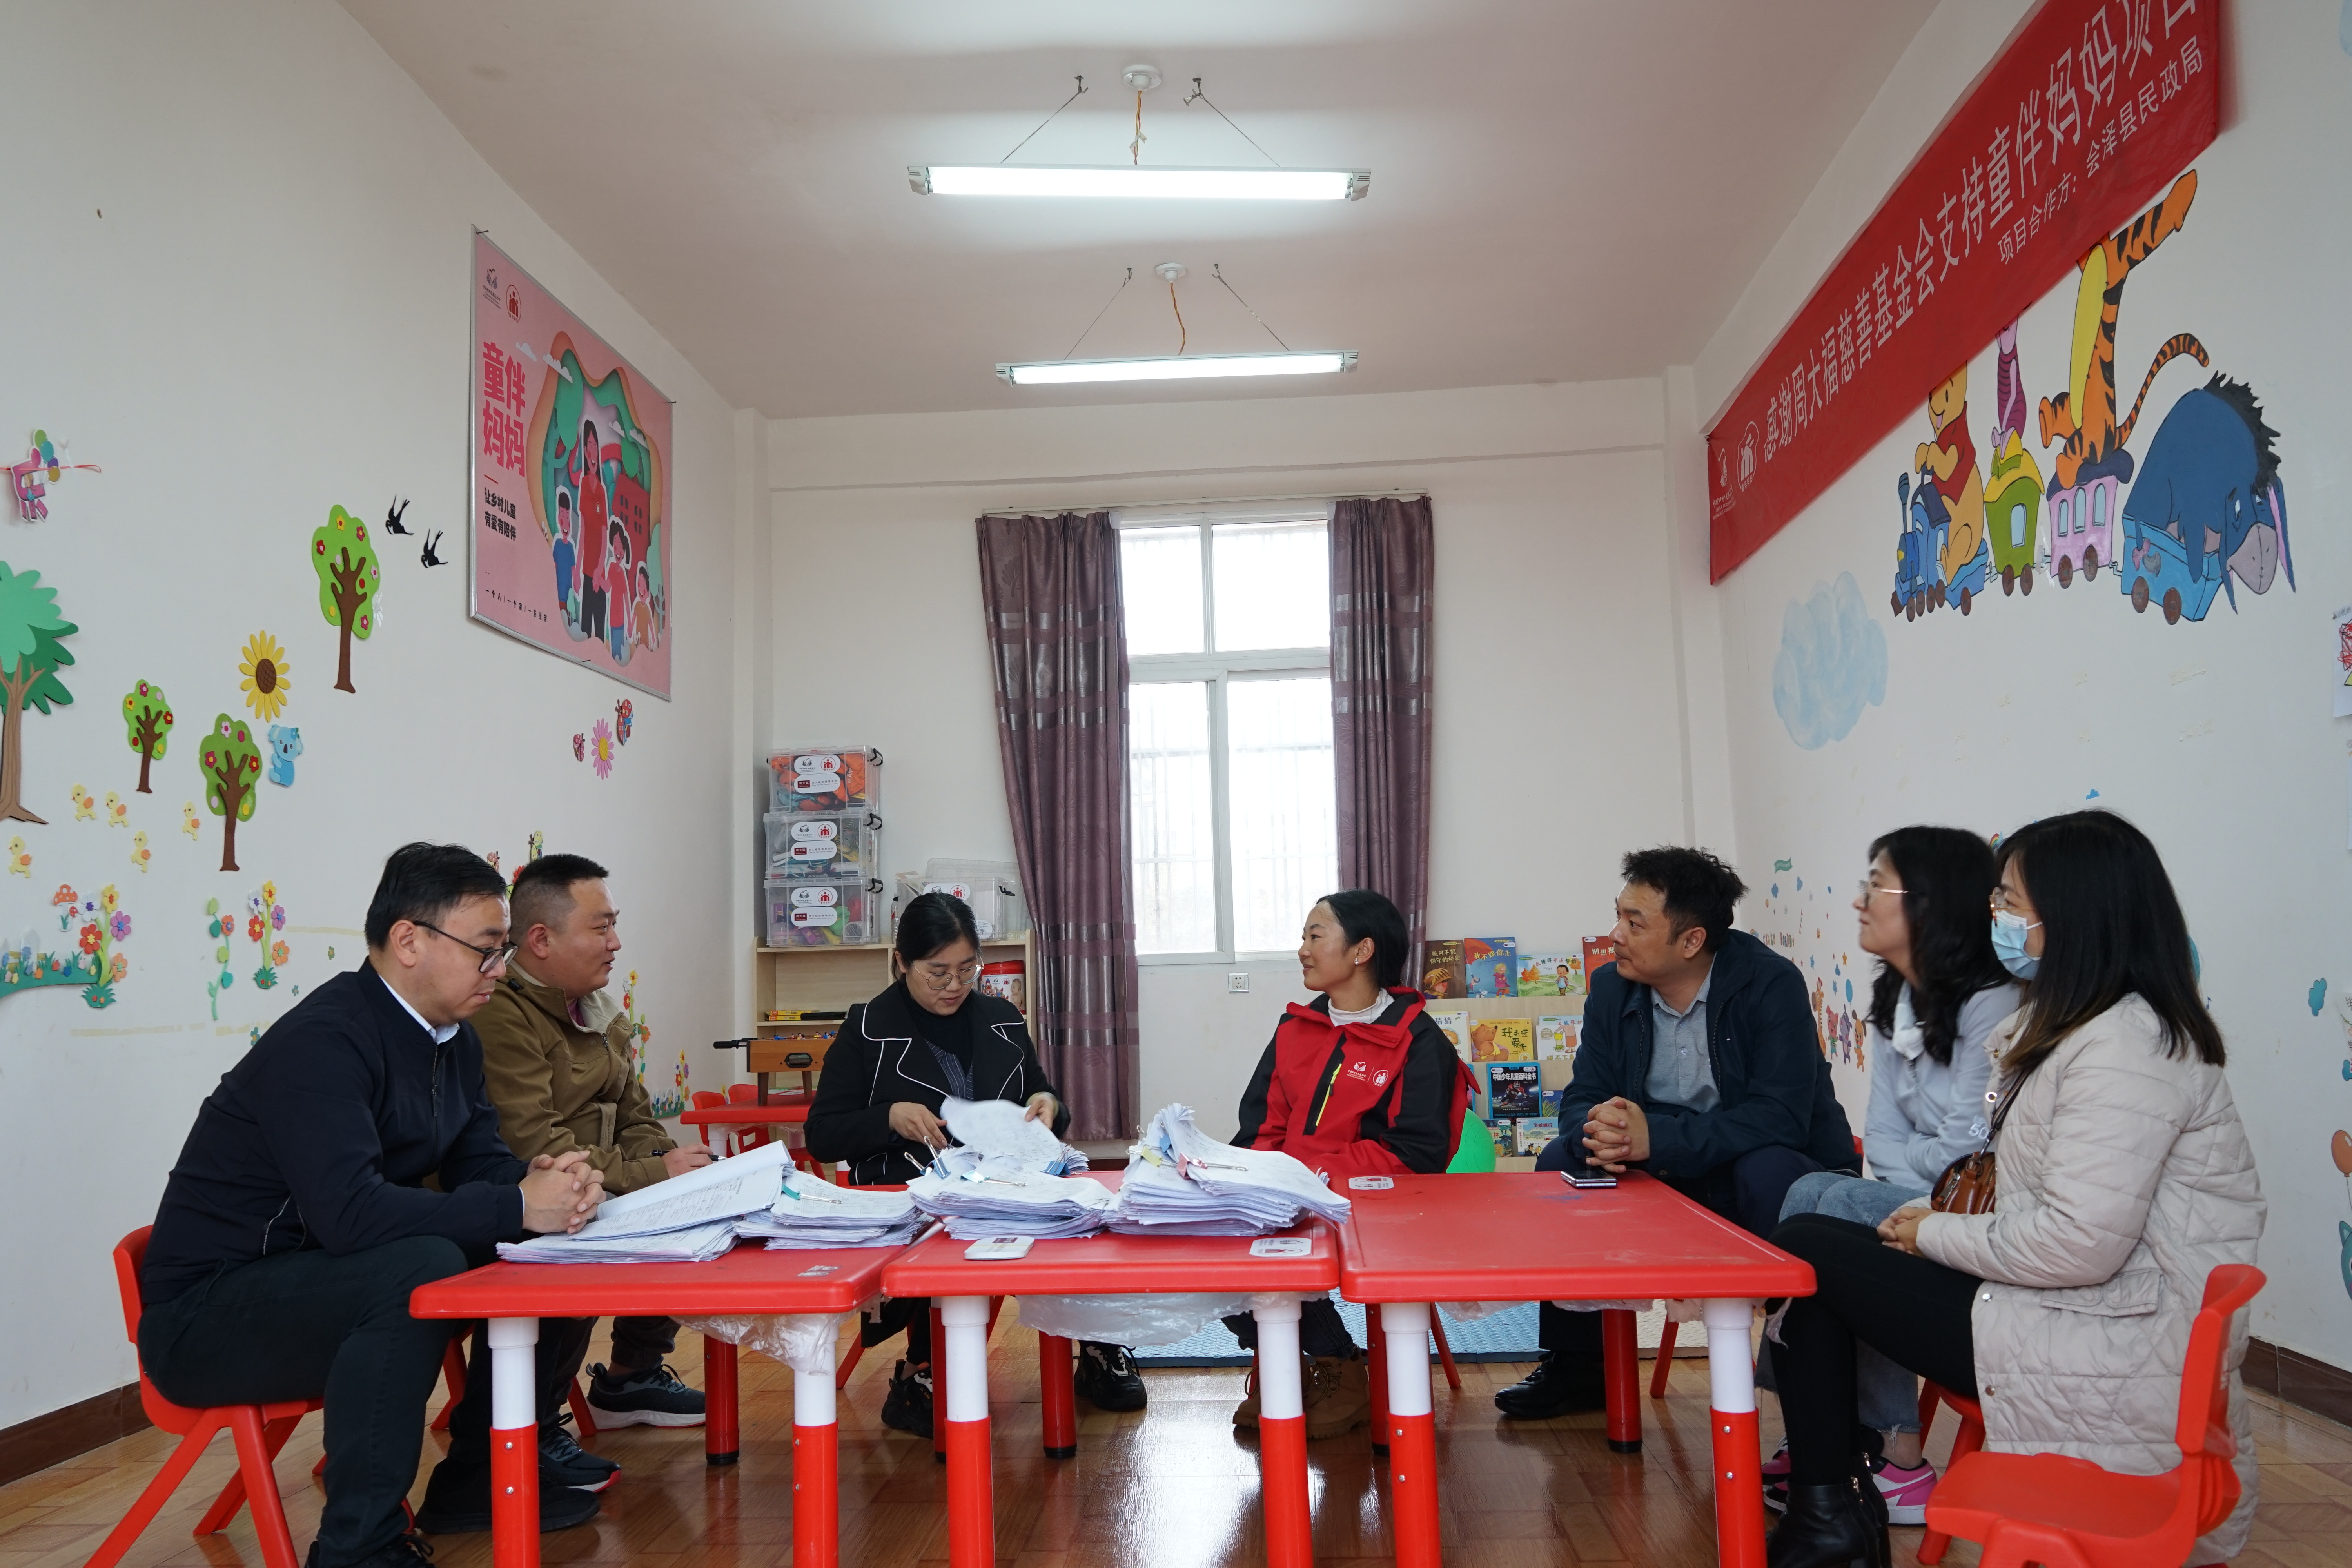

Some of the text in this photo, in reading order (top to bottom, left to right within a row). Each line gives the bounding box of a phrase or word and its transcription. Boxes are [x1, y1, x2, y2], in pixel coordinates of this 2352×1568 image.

[483, 341, 525, 418] 童伴
[483, 399, 525, 478] 妈妈
[485, 487, 516, 520] 让乡村儿童
[485, 511, 516, 541] 有爱有陪伴
[1432, 949, 1457, 957] 绝对不能
[1474, 949, 1512, 960] 我不跟你走
[1430, 955, 1461, 964] 保守的秘密
[1535, 958, 1577, 967] 我懂得寻求帮助
[1501, 1027, 1528, 1038] 我永远
[1511, 1038, 1527, 1052] 爱你
[1492, 1072, 1537, 1081] 中国少年儿童百科全书
